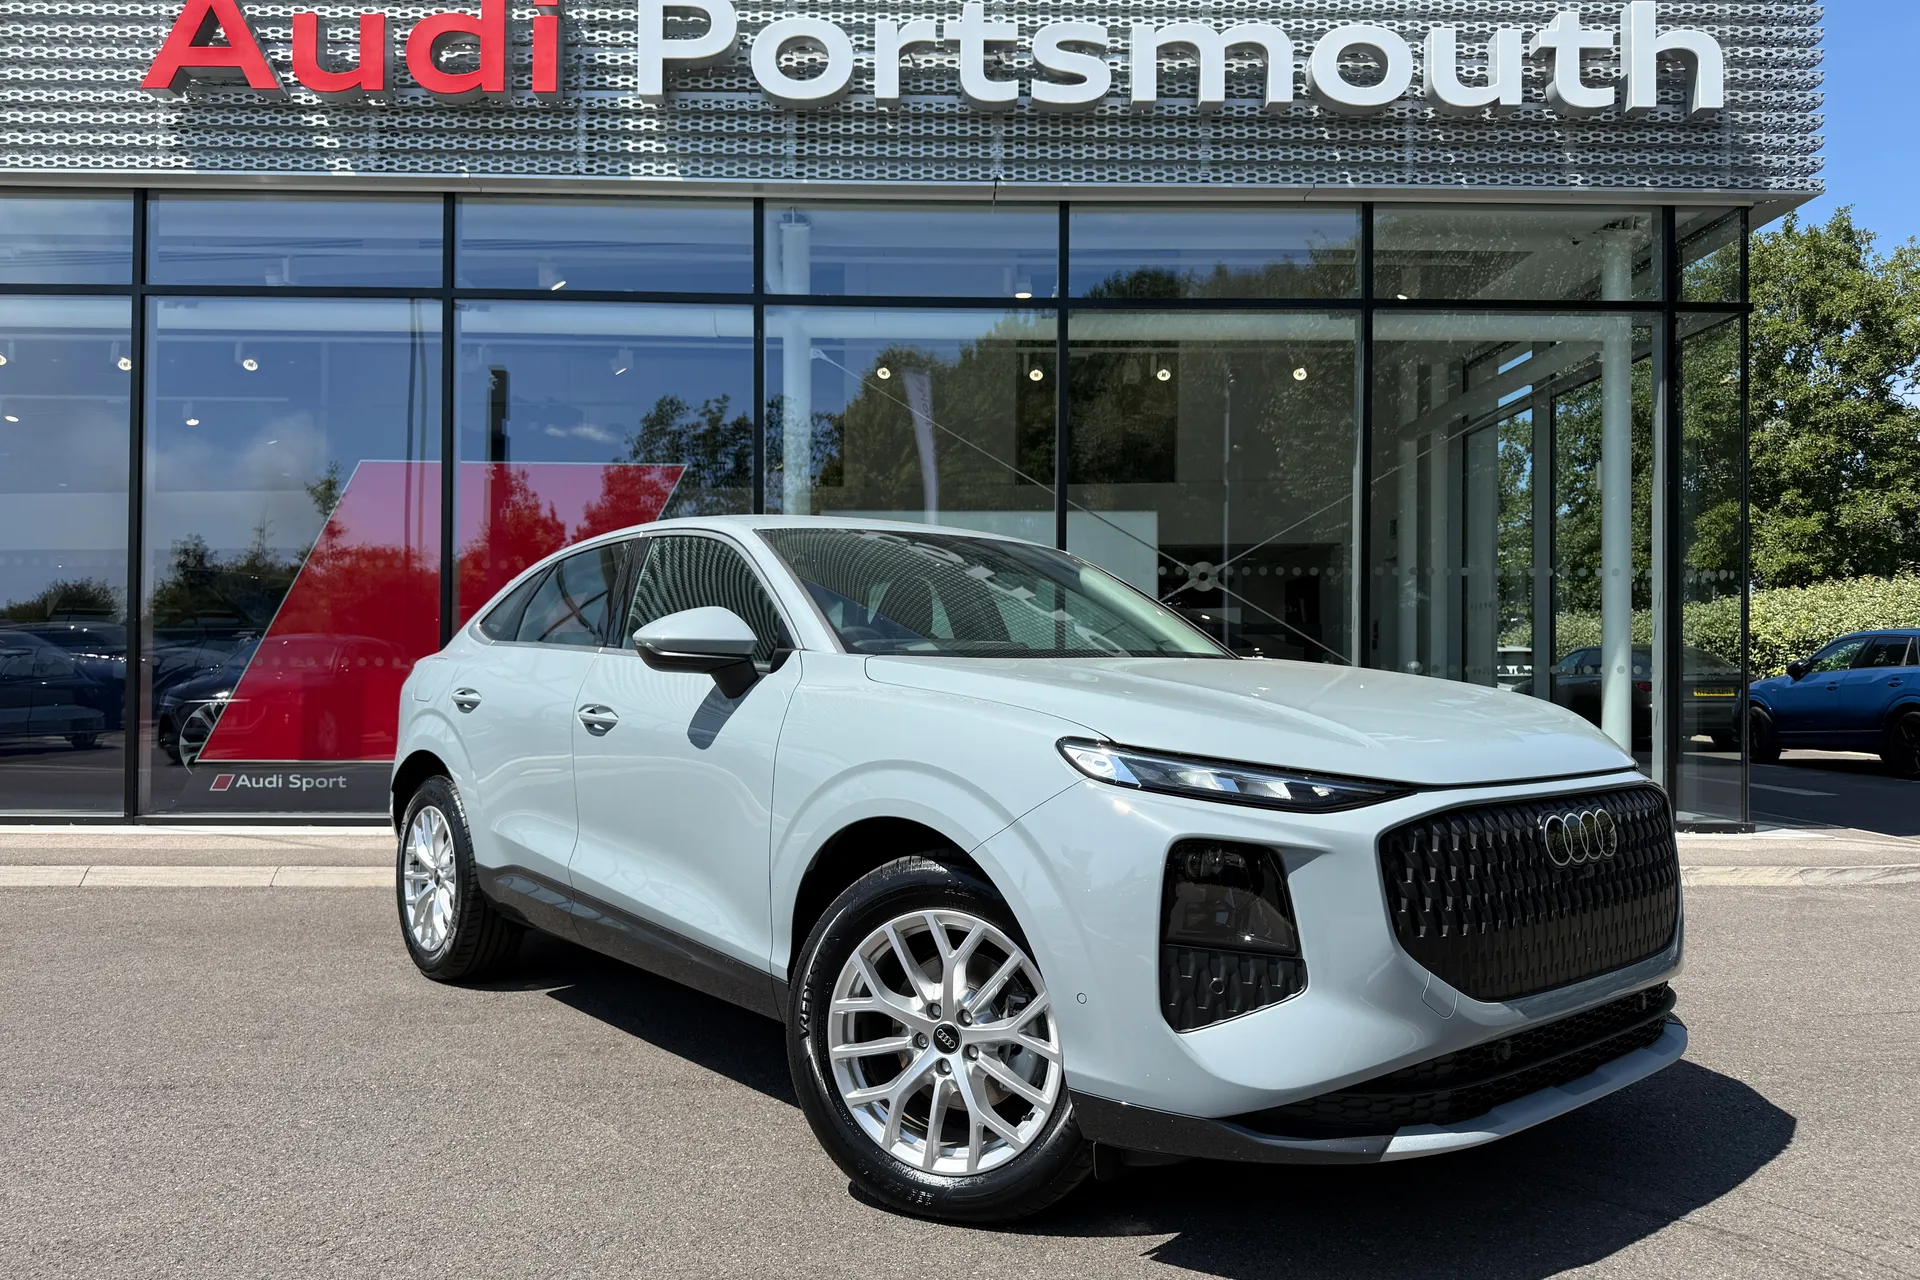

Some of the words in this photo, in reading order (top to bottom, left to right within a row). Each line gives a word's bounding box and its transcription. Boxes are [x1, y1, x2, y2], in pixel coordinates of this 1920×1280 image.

[141, 0, 560, 94] Audi
[637, 0, 1724, 111] Portsmouth
[235, 774, 283, 788] Audi
[288, 774, 347, 792] Sport
